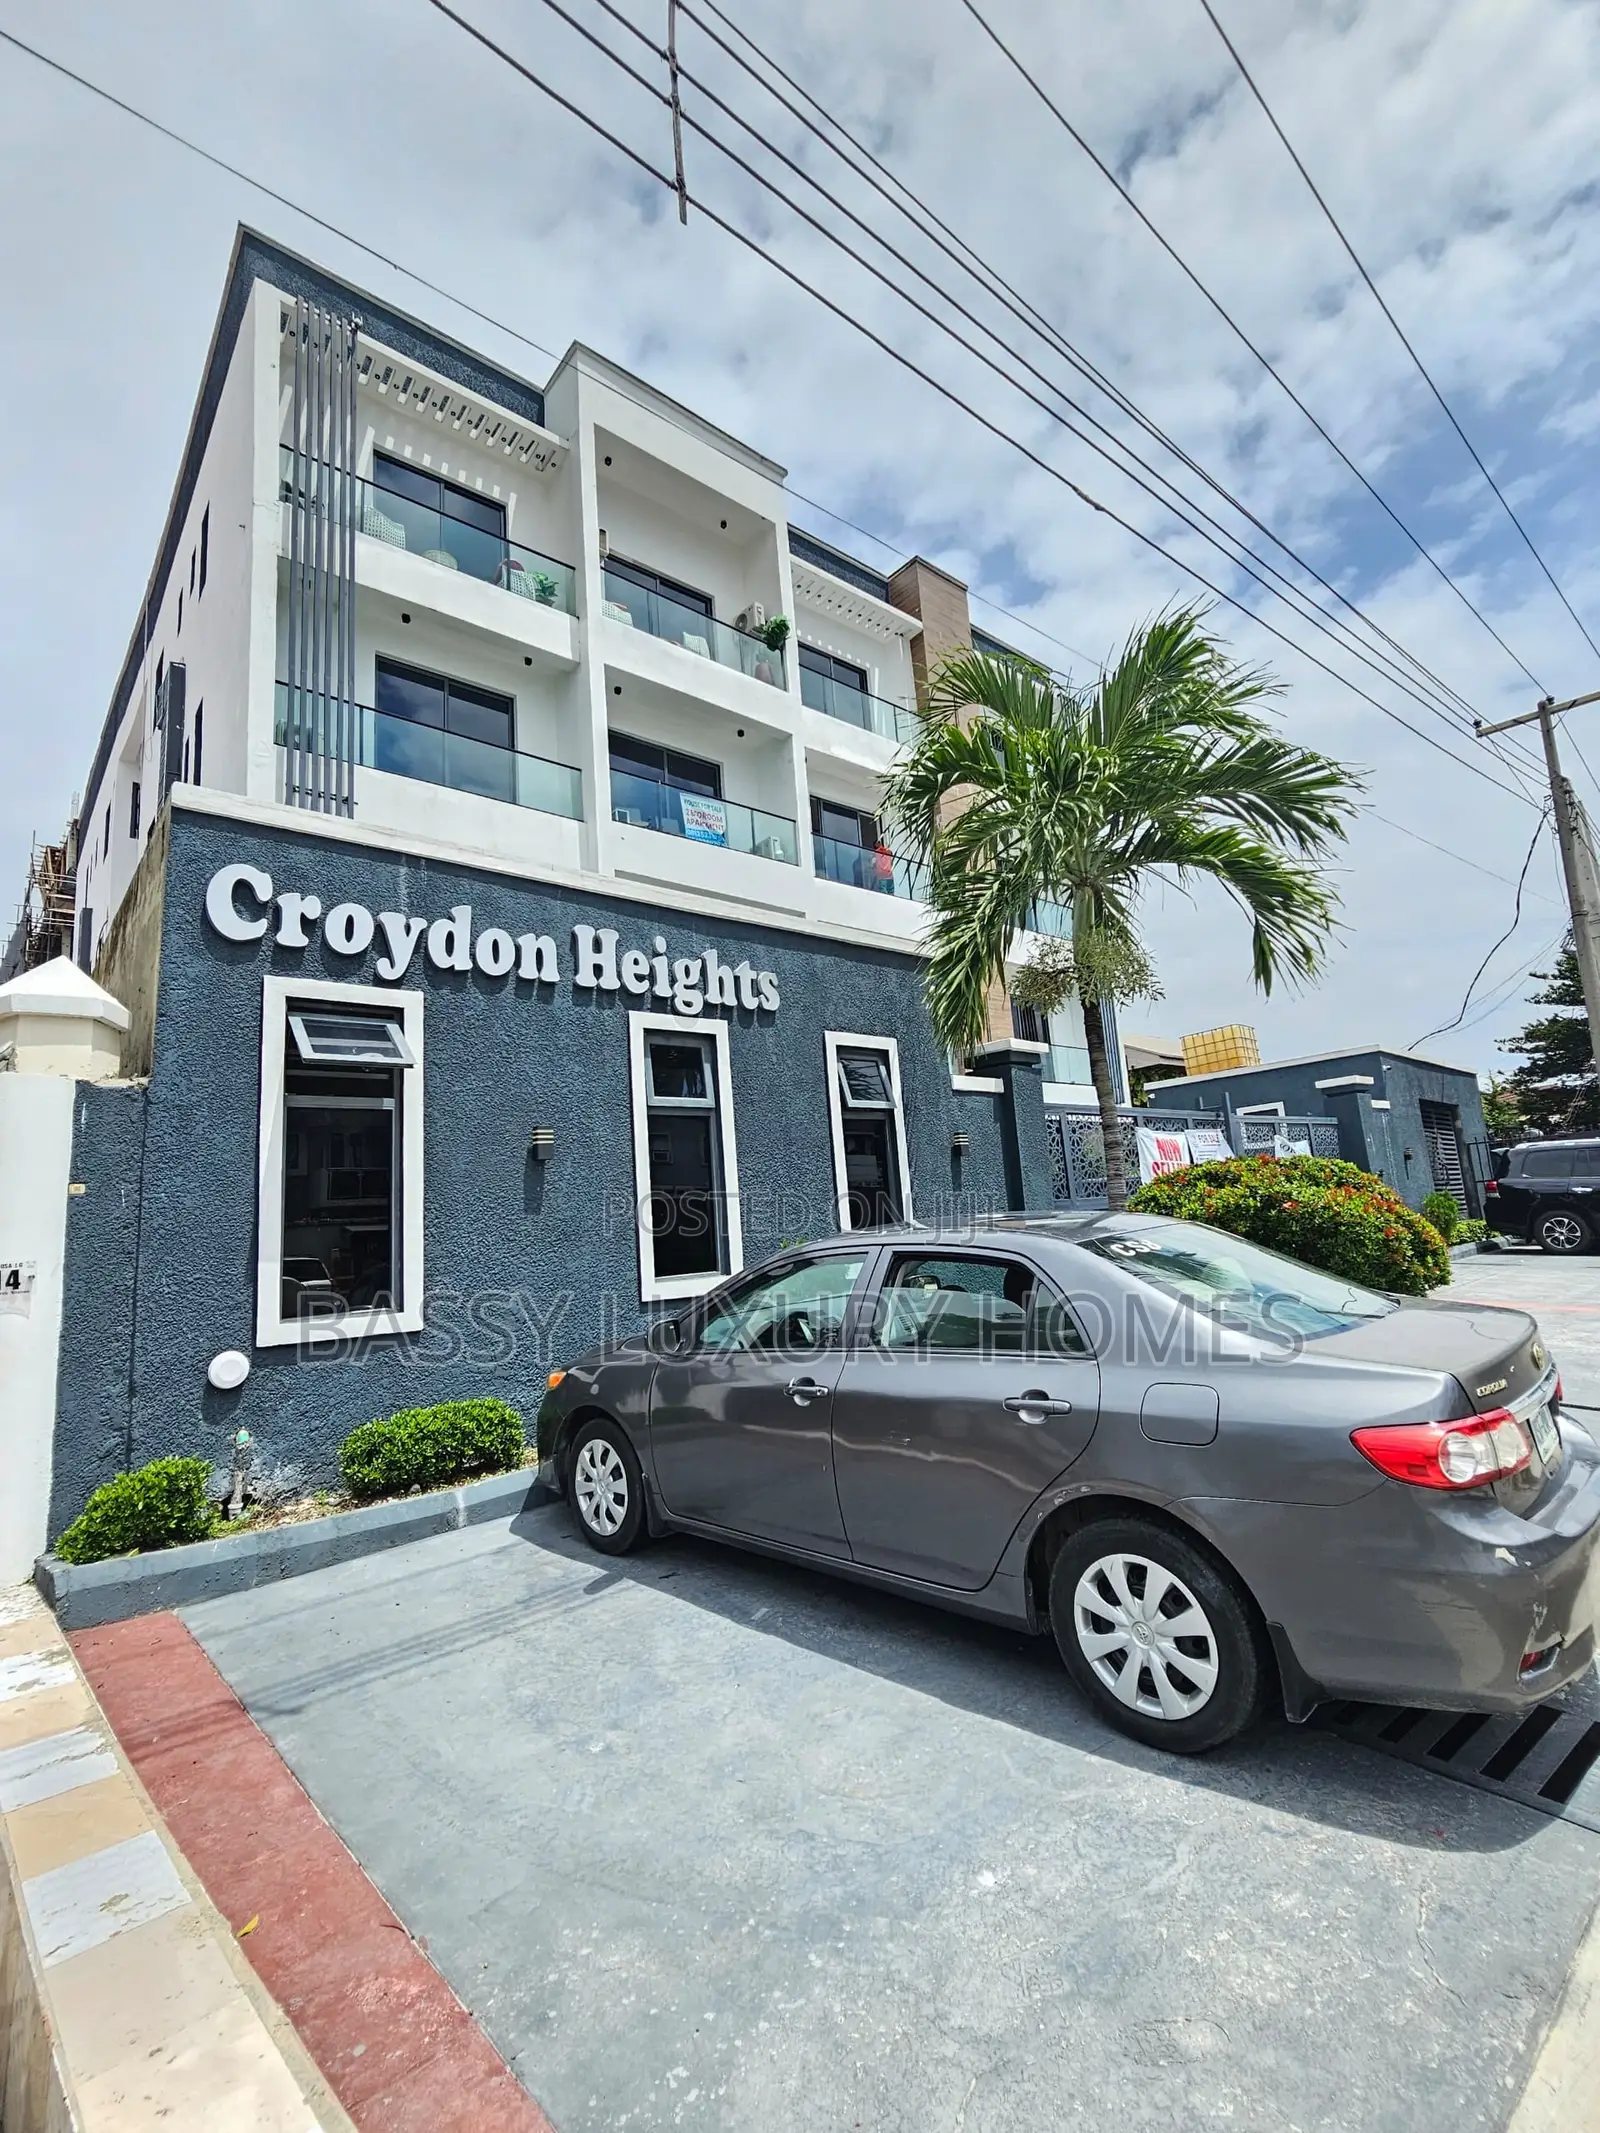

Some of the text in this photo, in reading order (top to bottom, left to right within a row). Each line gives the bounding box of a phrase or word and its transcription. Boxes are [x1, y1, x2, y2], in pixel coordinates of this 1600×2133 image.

[205, 863, 781, 1015] Croydon Heights
[1155, 1137, 1183, 1161] NOW
[0, 1269, 21, 1290] 4
